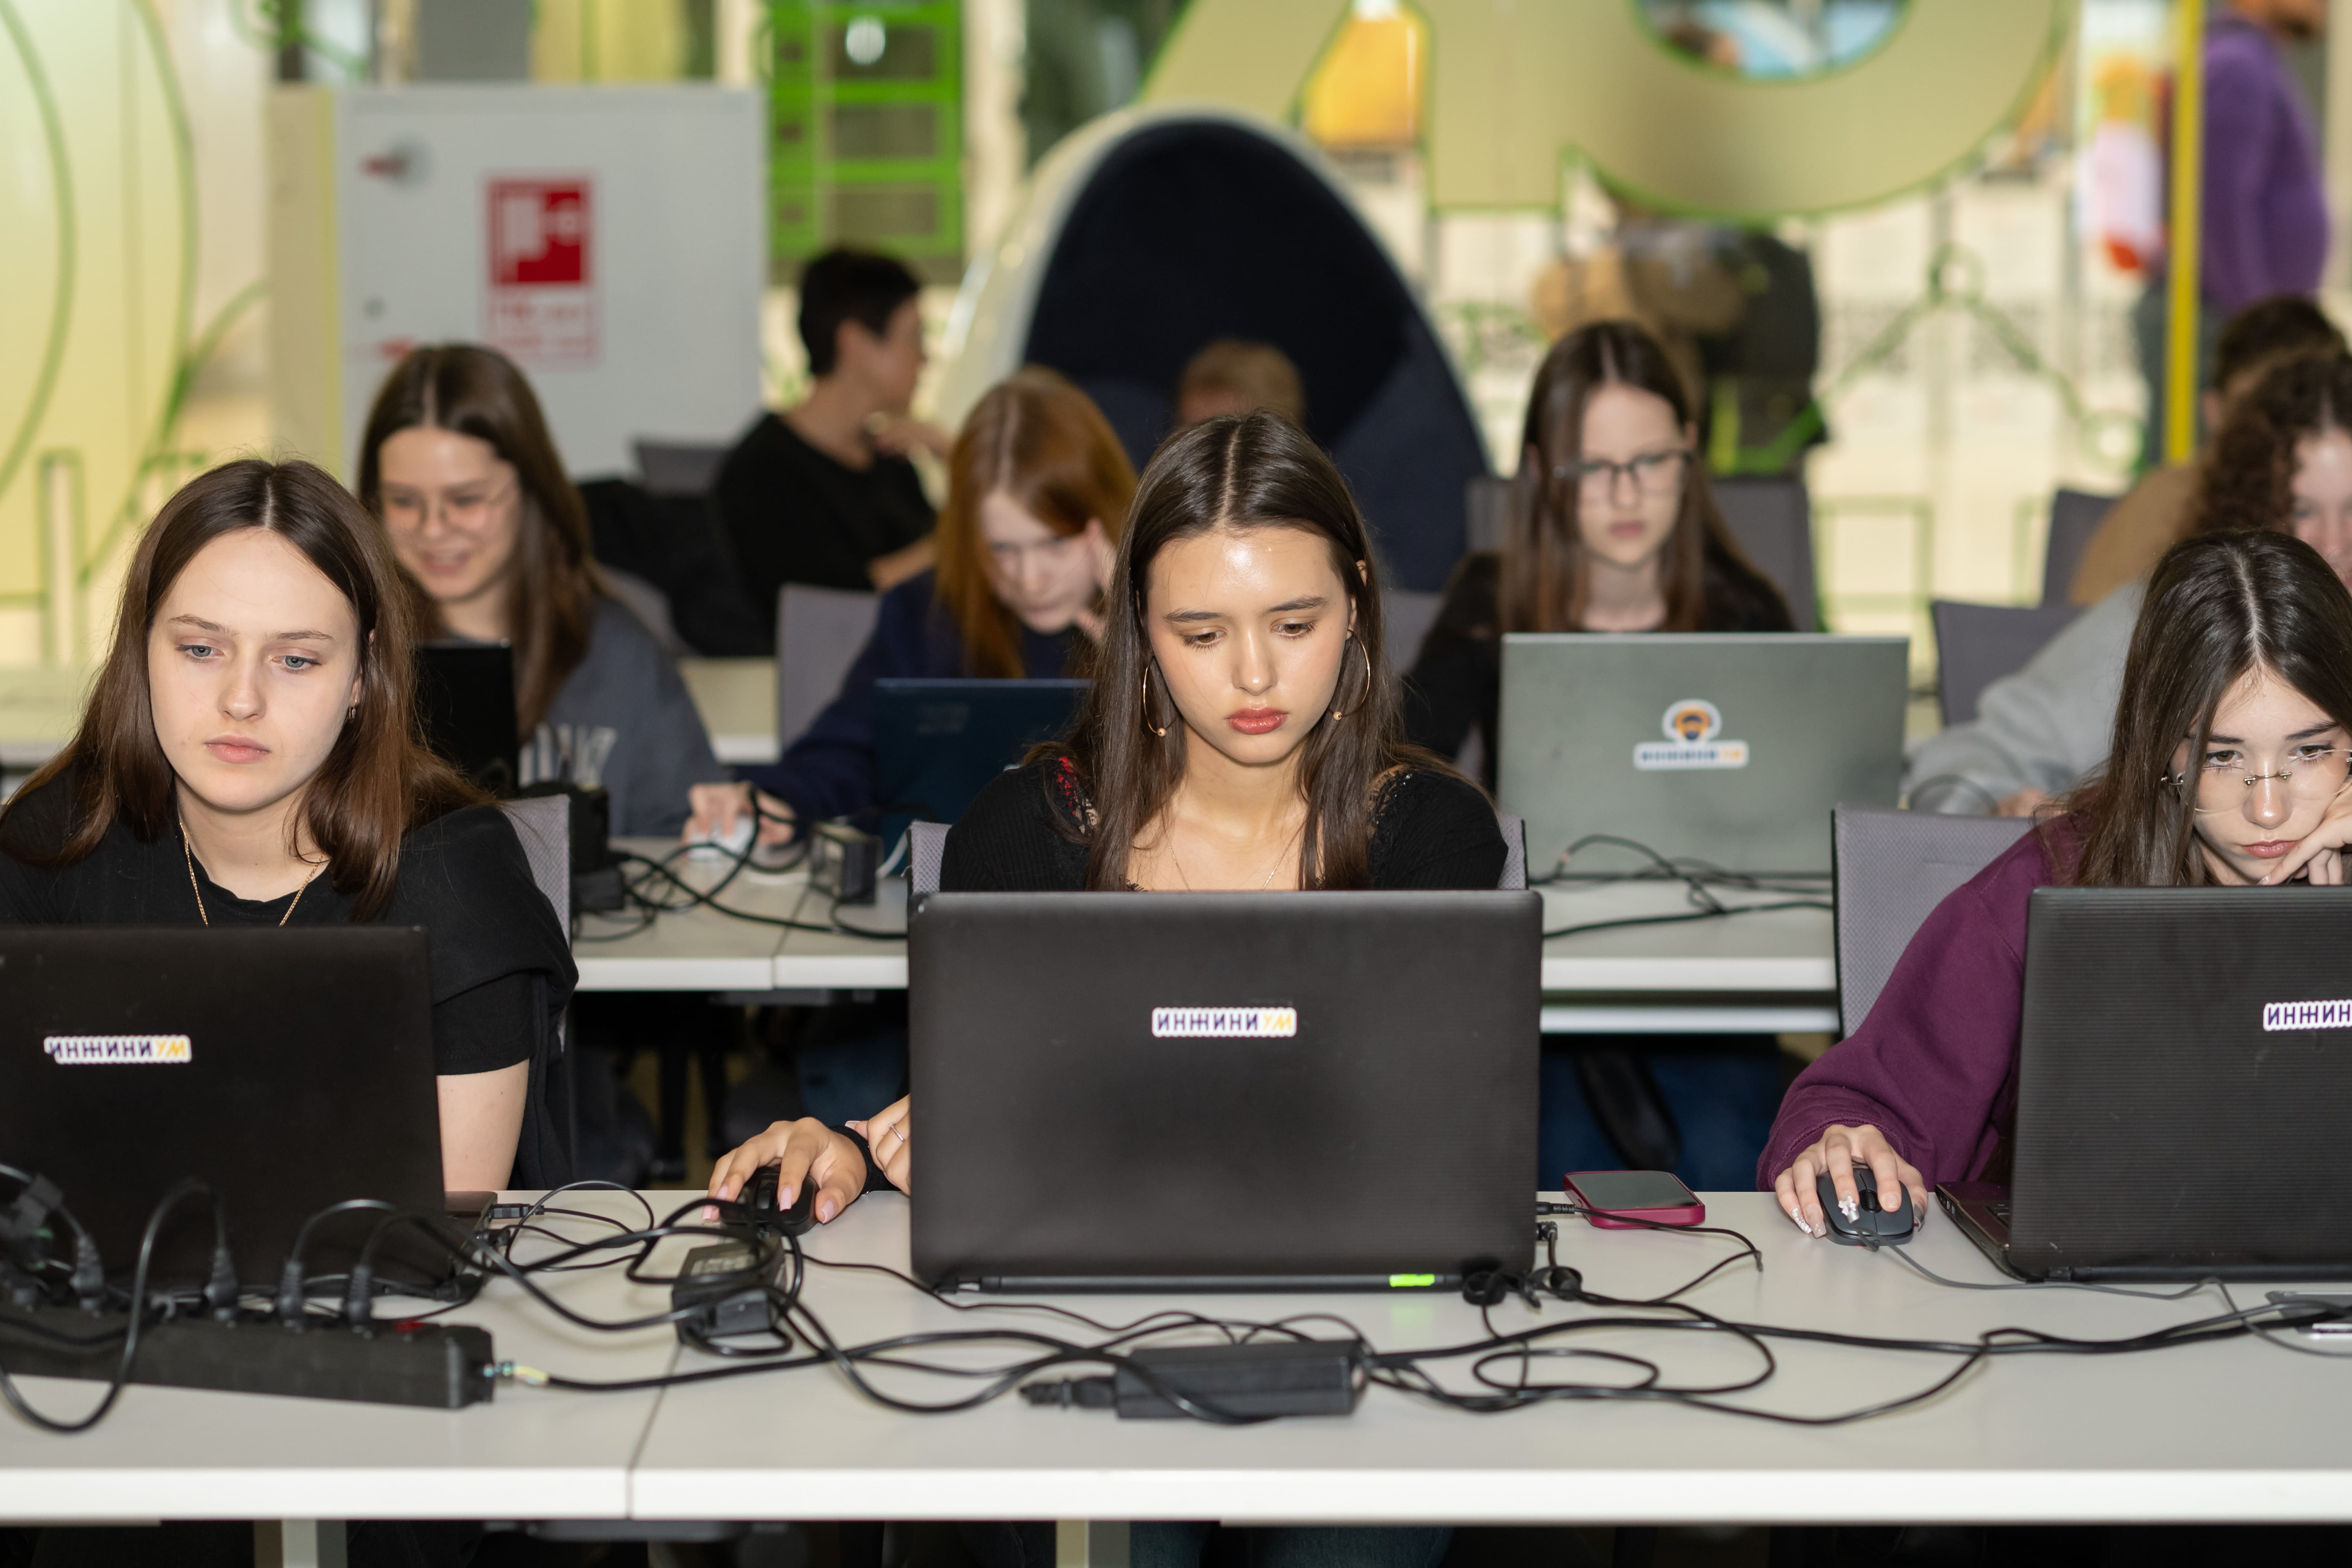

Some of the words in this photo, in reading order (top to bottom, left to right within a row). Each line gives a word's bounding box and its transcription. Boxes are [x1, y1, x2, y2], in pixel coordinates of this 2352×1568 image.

[1158, 1013, 1292, 1031] ИНЖИНИУМ
[2268, 1004, 2350, 1025] ИНЖИН
[49, 1040, 186, 1057] ИНЖИНИУМ
